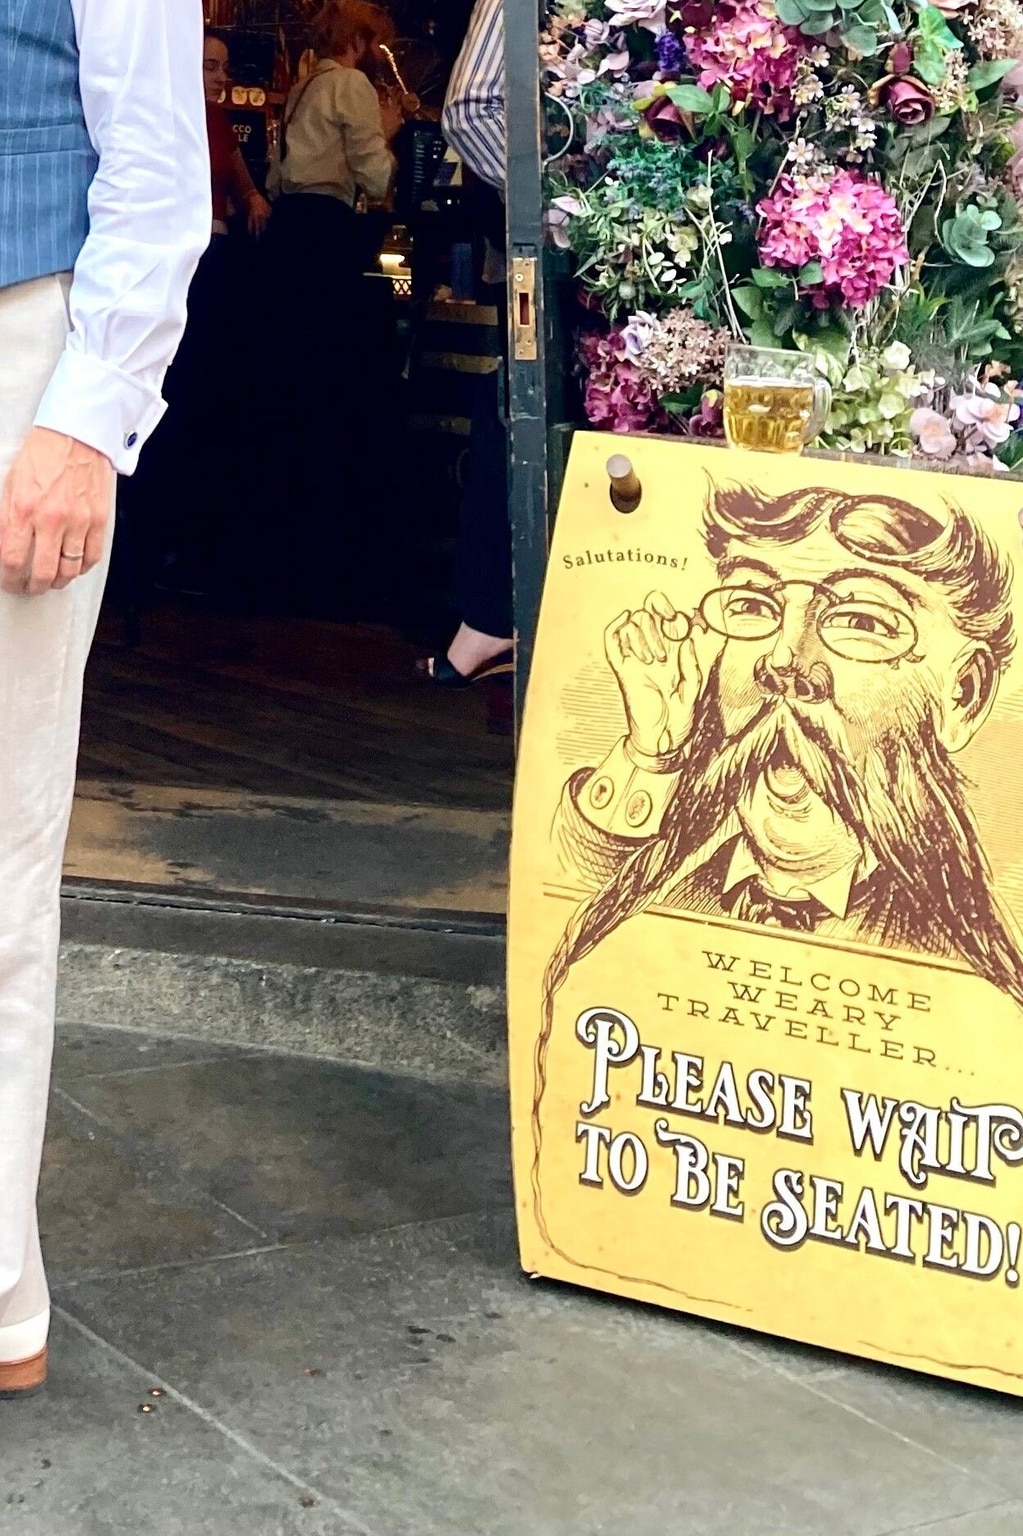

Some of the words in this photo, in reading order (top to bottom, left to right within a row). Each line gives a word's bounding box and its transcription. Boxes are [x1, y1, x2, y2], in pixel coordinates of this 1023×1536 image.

[562, 547, 688, 571] Salutations!
[701, 950, 932, 1013] WELCOME
[727, 980, 902, 1032] WEARY
[657, 992, 976, 1078] TRAVELLER...
[575, 1006, 814, 1146] PLEASE
[840, 1086, 1023, 1191] WAIT
[575, 1120, 649, 1197] TO
[653, 1117, 745, 1224] BE
[760, 1167, 1022, 1290] SEATED!
